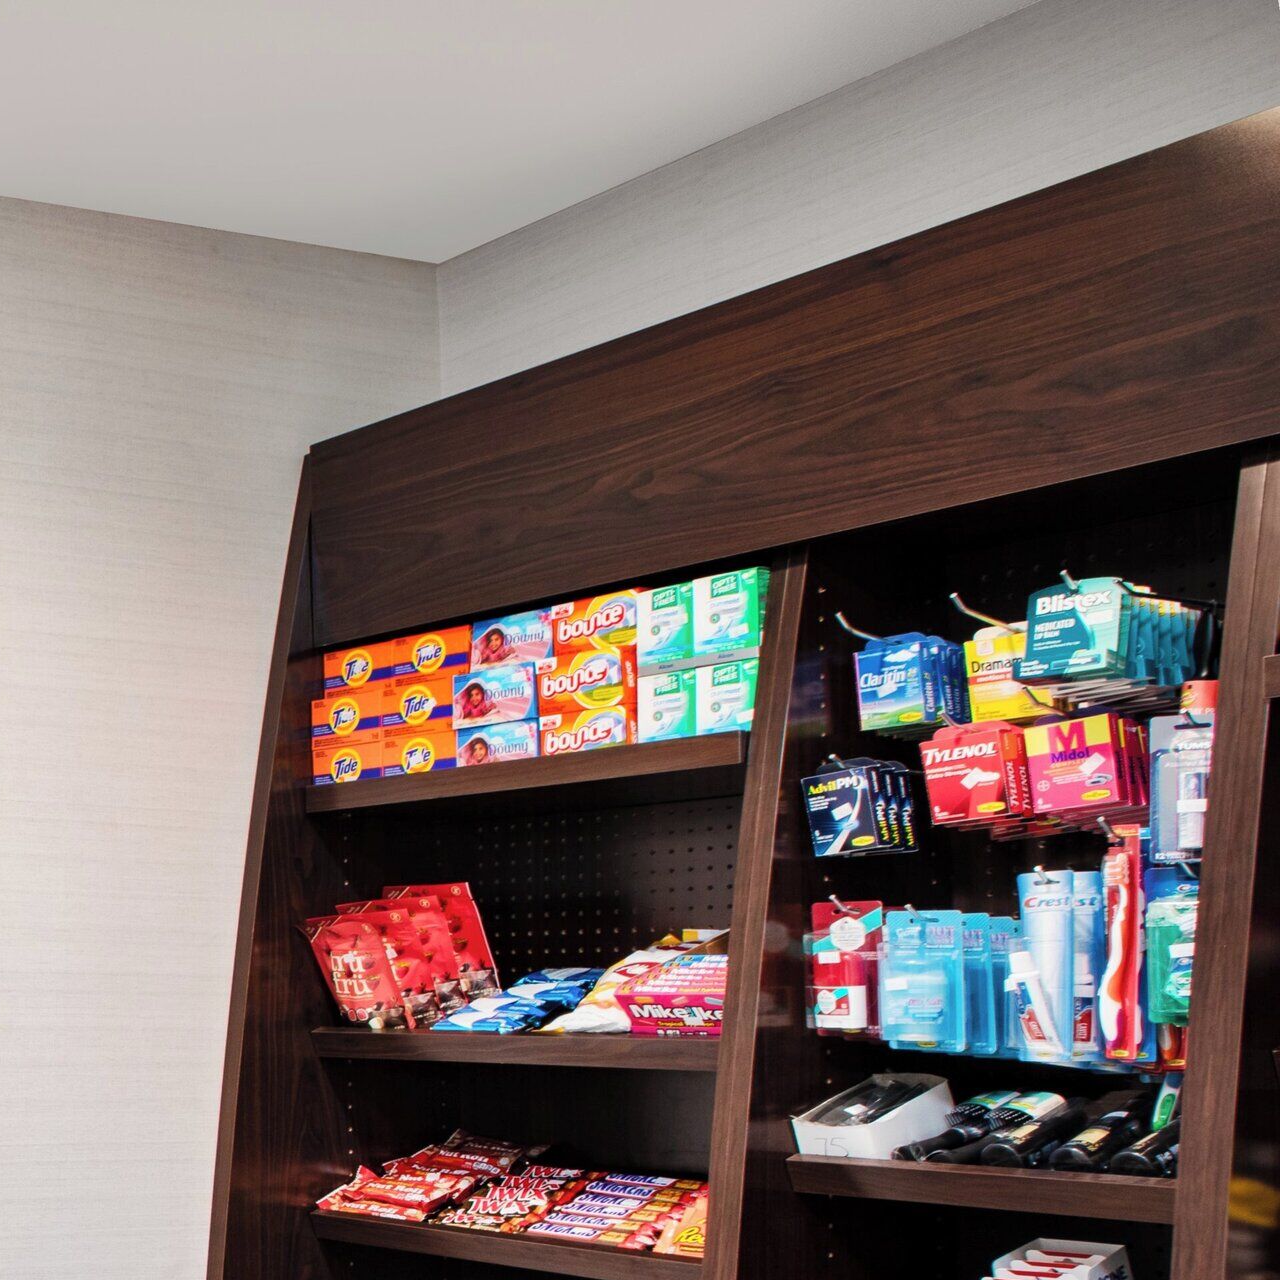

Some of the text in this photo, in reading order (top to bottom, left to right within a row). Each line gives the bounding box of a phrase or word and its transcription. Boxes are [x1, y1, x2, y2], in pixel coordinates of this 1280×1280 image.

[713, 584, 737, 597] FREE
[654, 597, 676, 609] FREE
[1035, 591, 1112, 615] Blistex
[558, 603, 626, 642] bounce
[416, 644, 442, 667] Te
[345, 659, 369, 681] Tie
[542, 659, 609, 698] bounce
[860, 669, 907, 688] Claritin
[656, 683, 678, 696] FREE
[925, 682, 936, 713] Claritin
[333, 708, 357, 729] Te
[545, 717, 614, 755] bounce
[1048, 722, 1087, 752] M
[406, 748, 431, 770] Te
[923, 741, 998, 766] TYLENOL
[1051, 747, 1090, 763] Midol
[335, 758, 358, 780] Tide
[1006, 761, 1019, 808] TYLENOL
[1019, 765, 1032, 811] TYLENOL
[1025, 896, 1071, 909] Crest
[333, 974, 373, 996] frü
[629, 1004, 686, 1019] Mike
[589, 1182, 653, 1197] SNICKERS
[566, 1203, 630, 1216] SNICKS
[578, 1194, 644, 1208] SNICKS
[532, 1222, 597, 1237] SNICKS
